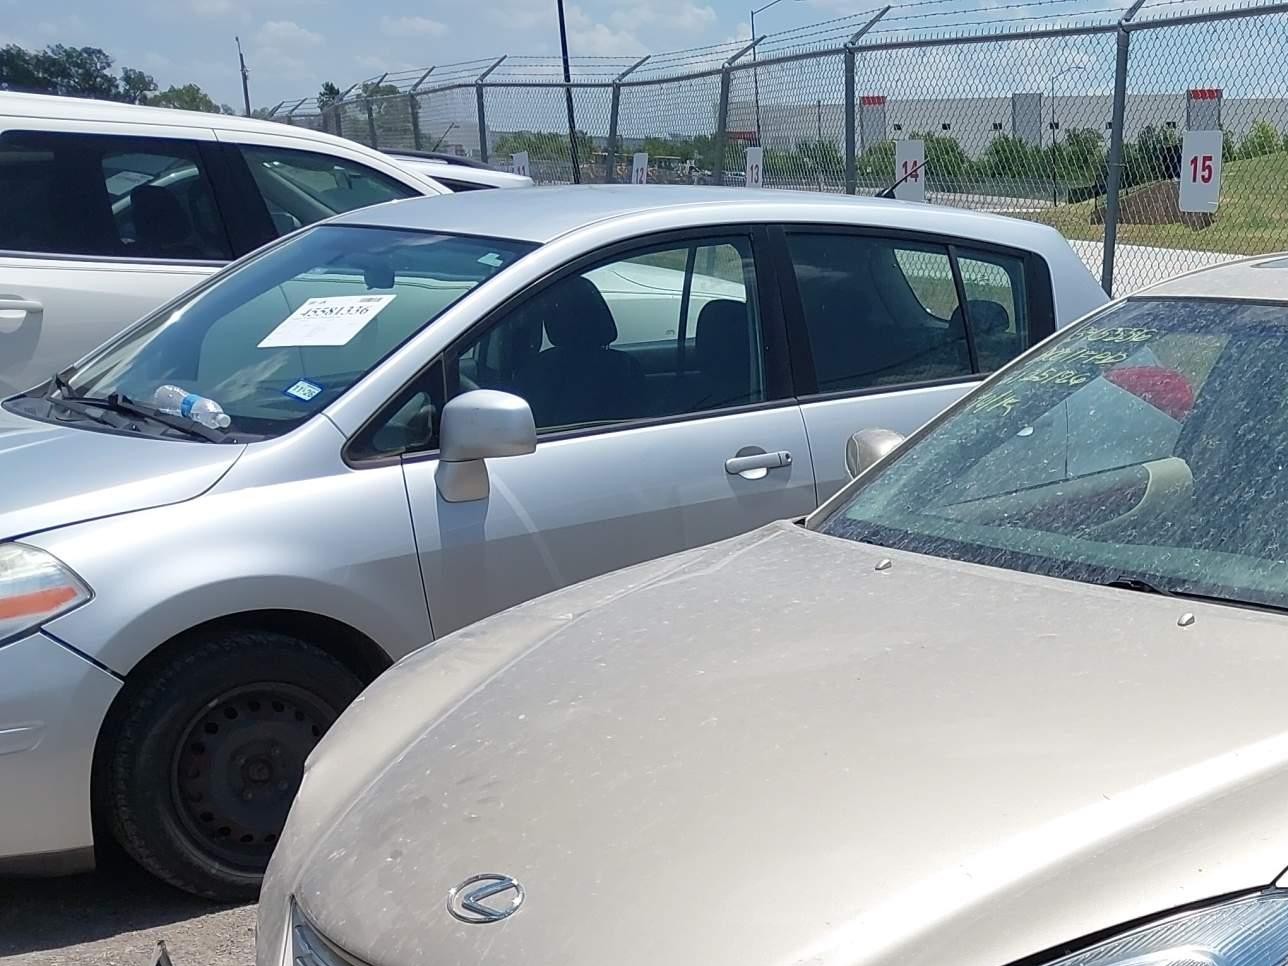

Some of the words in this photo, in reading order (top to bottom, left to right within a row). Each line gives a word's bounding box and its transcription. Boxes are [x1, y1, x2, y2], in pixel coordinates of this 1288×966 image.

[749, 164, 761, 184] 13
[902, 160, 919, 183] 14
[1189, 155, 1213, 184] 15
